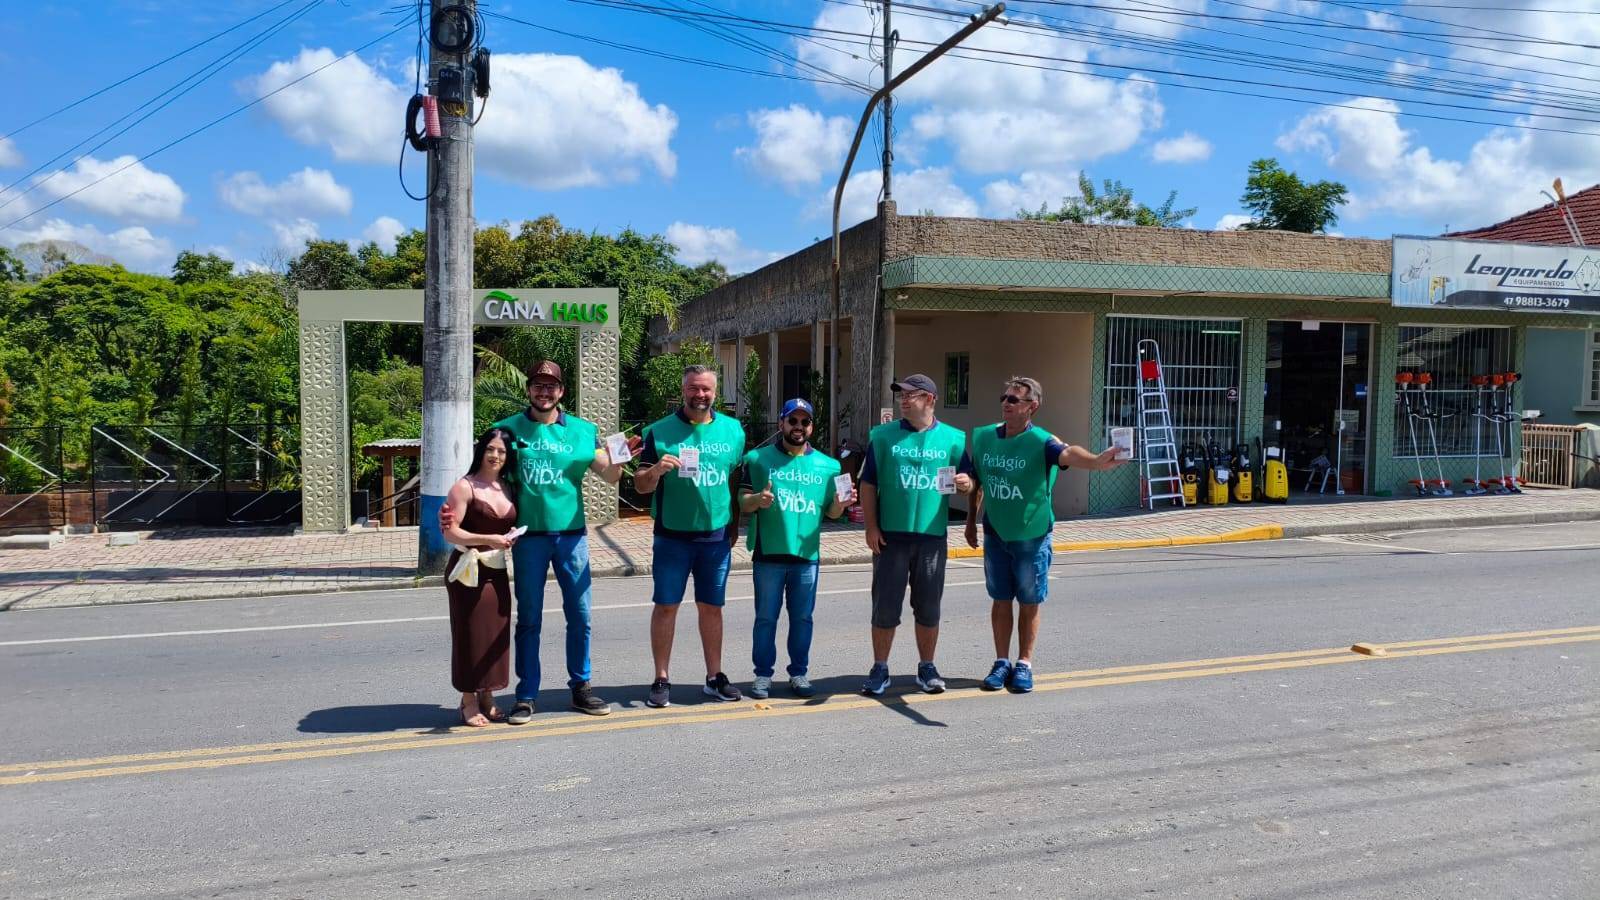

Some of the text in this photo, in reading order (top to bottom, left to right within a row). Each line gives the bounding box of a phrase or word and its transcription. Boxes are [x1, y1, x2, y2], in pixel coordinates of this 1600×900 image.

[1464, 254, 1575, 286] Leopardo
[1513, 279, 1565, 287] EQUIPAMENTOS
[1503, 296, 1570, 308] 47 98813-3679
[484, 300, 609, 323] CANA HAUS
[522, 459, 556, 470] RENAL
[900, 465, 934, 476] RENAL
[523, 469, 564, 484] VIDA
[768, 468, 823, 486] Pedágio
[777, 488, 805, 499] RENAL
[990, 485, 1024, 500] VIDA
[778, 496, 817, 515] VIDA
